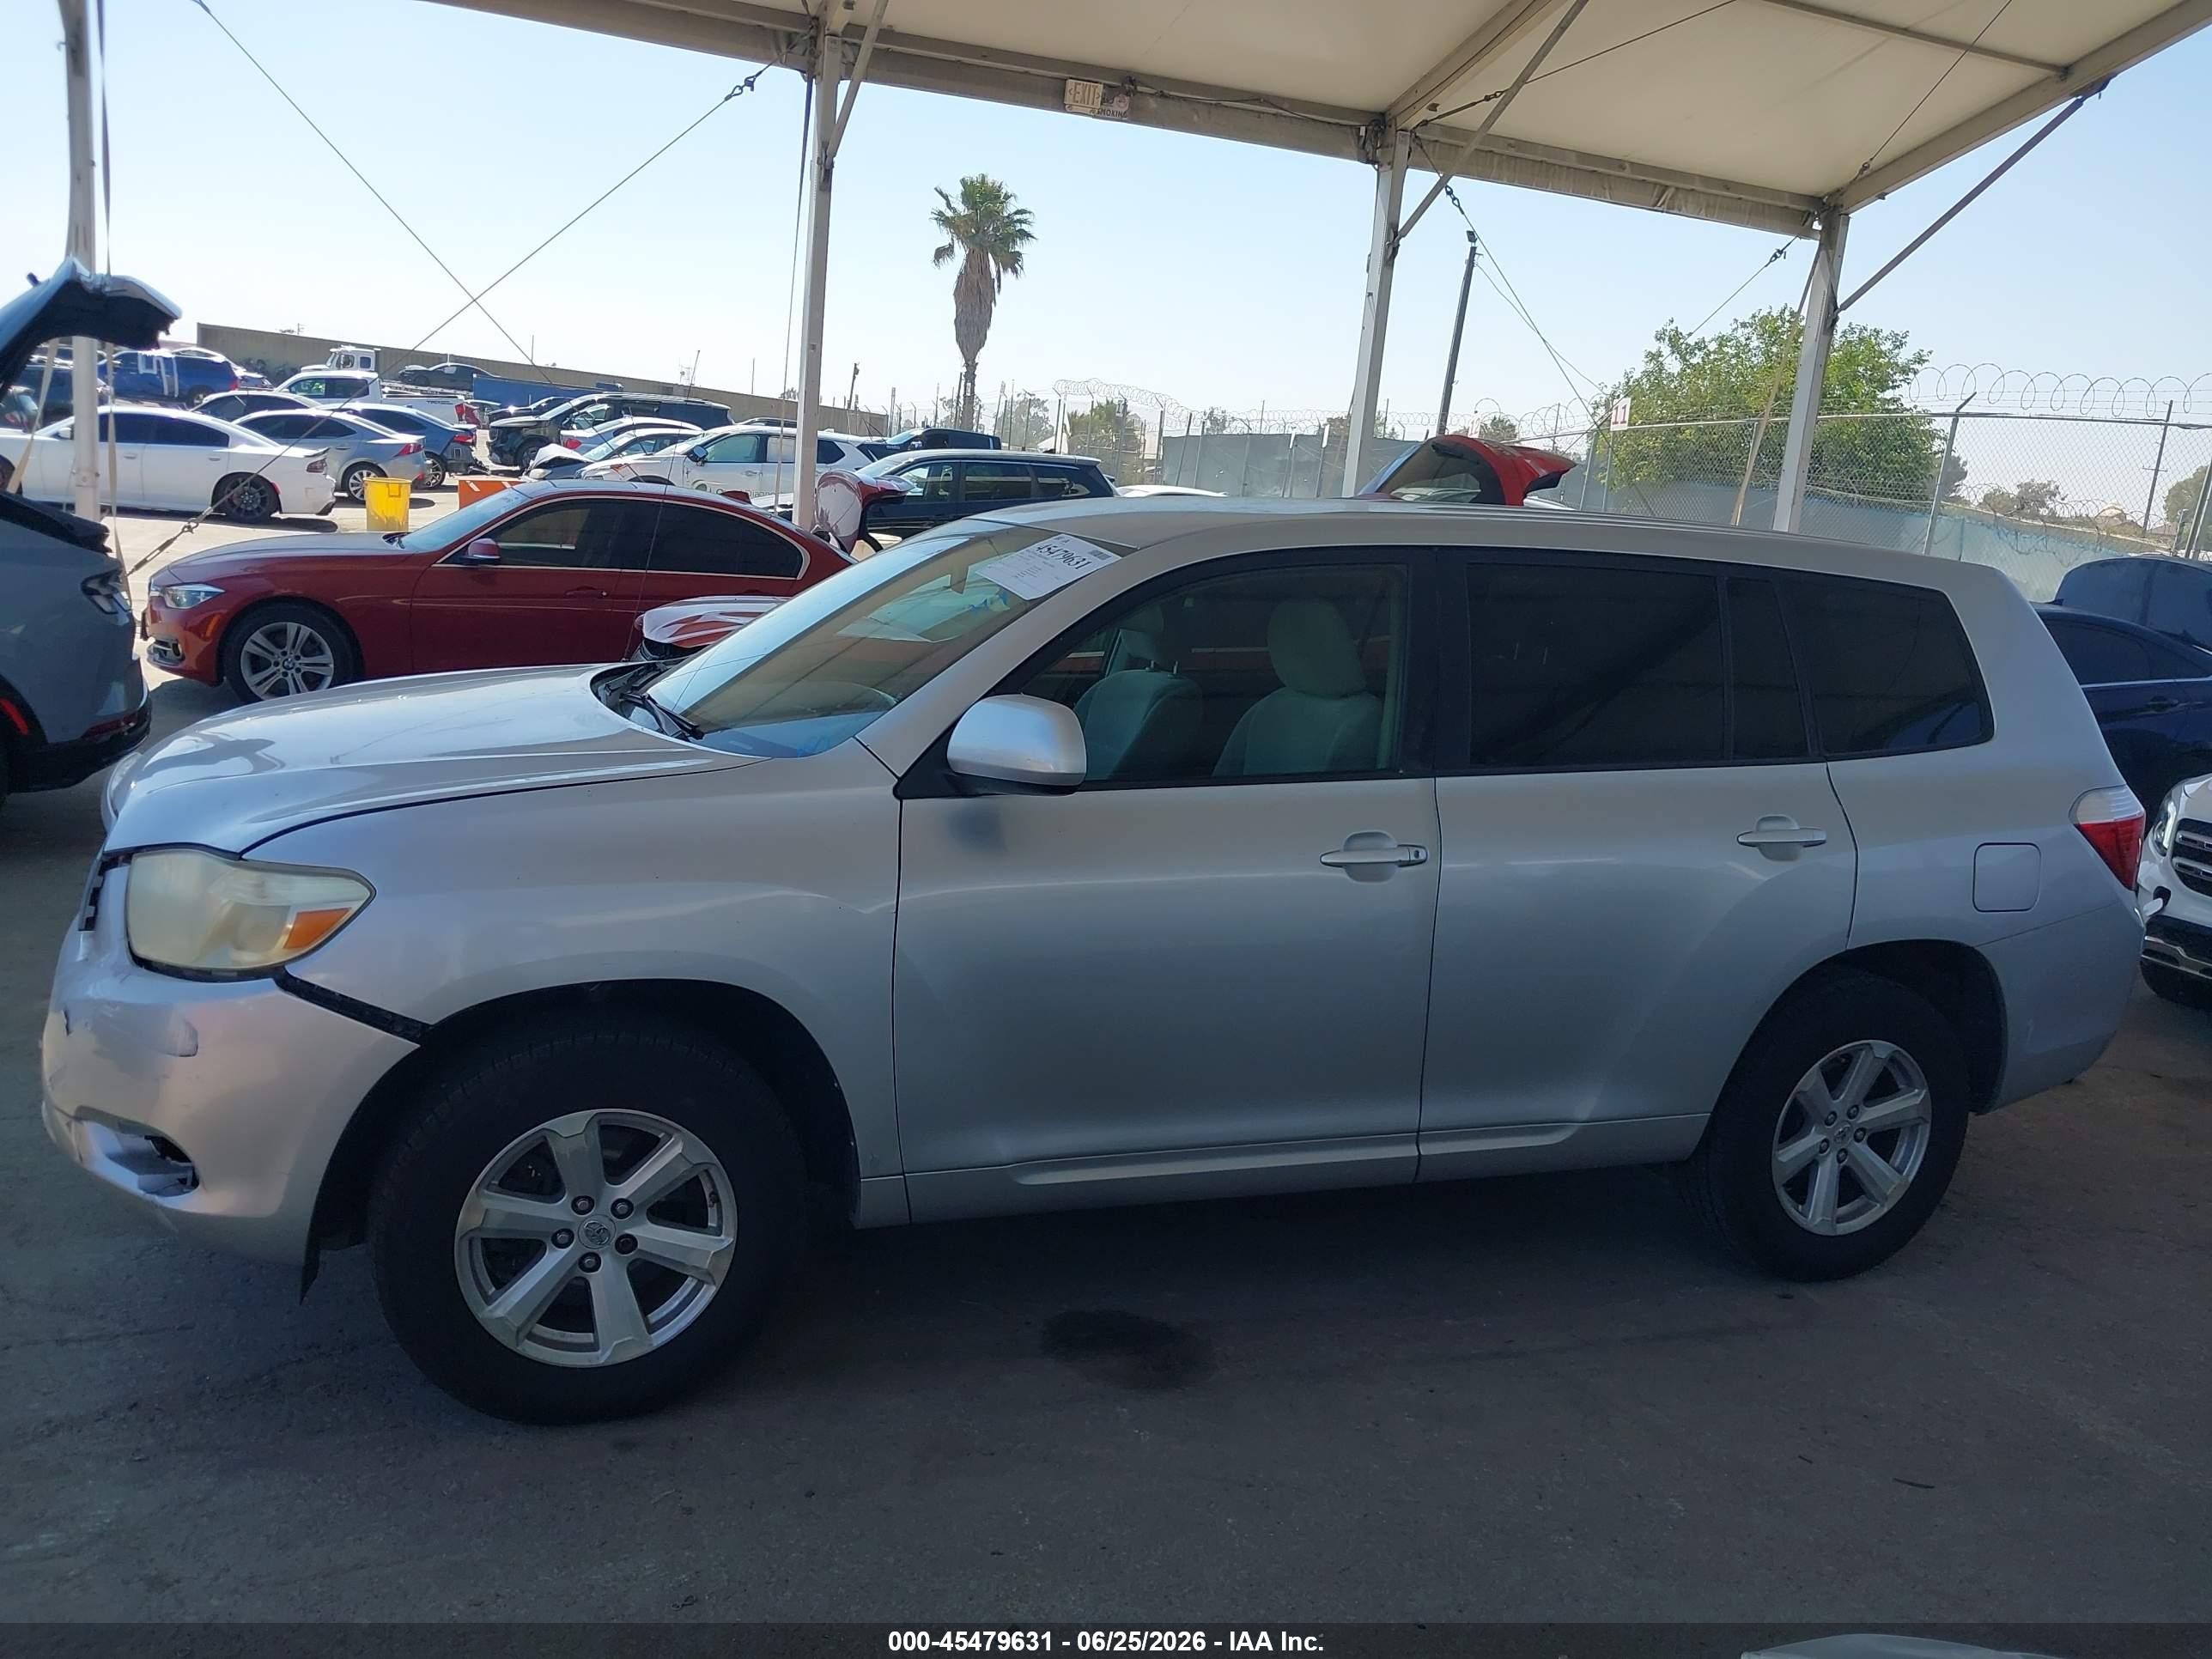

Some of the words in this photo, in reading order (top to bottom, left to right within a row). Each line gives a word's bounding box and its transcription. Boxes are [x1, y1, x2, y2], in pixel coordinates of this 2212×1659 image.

[1073, 82, 1099, 106] EXIT
[1612, 404, 1628, 426] 11
[1034, 543, 1093, 570] 45479631
